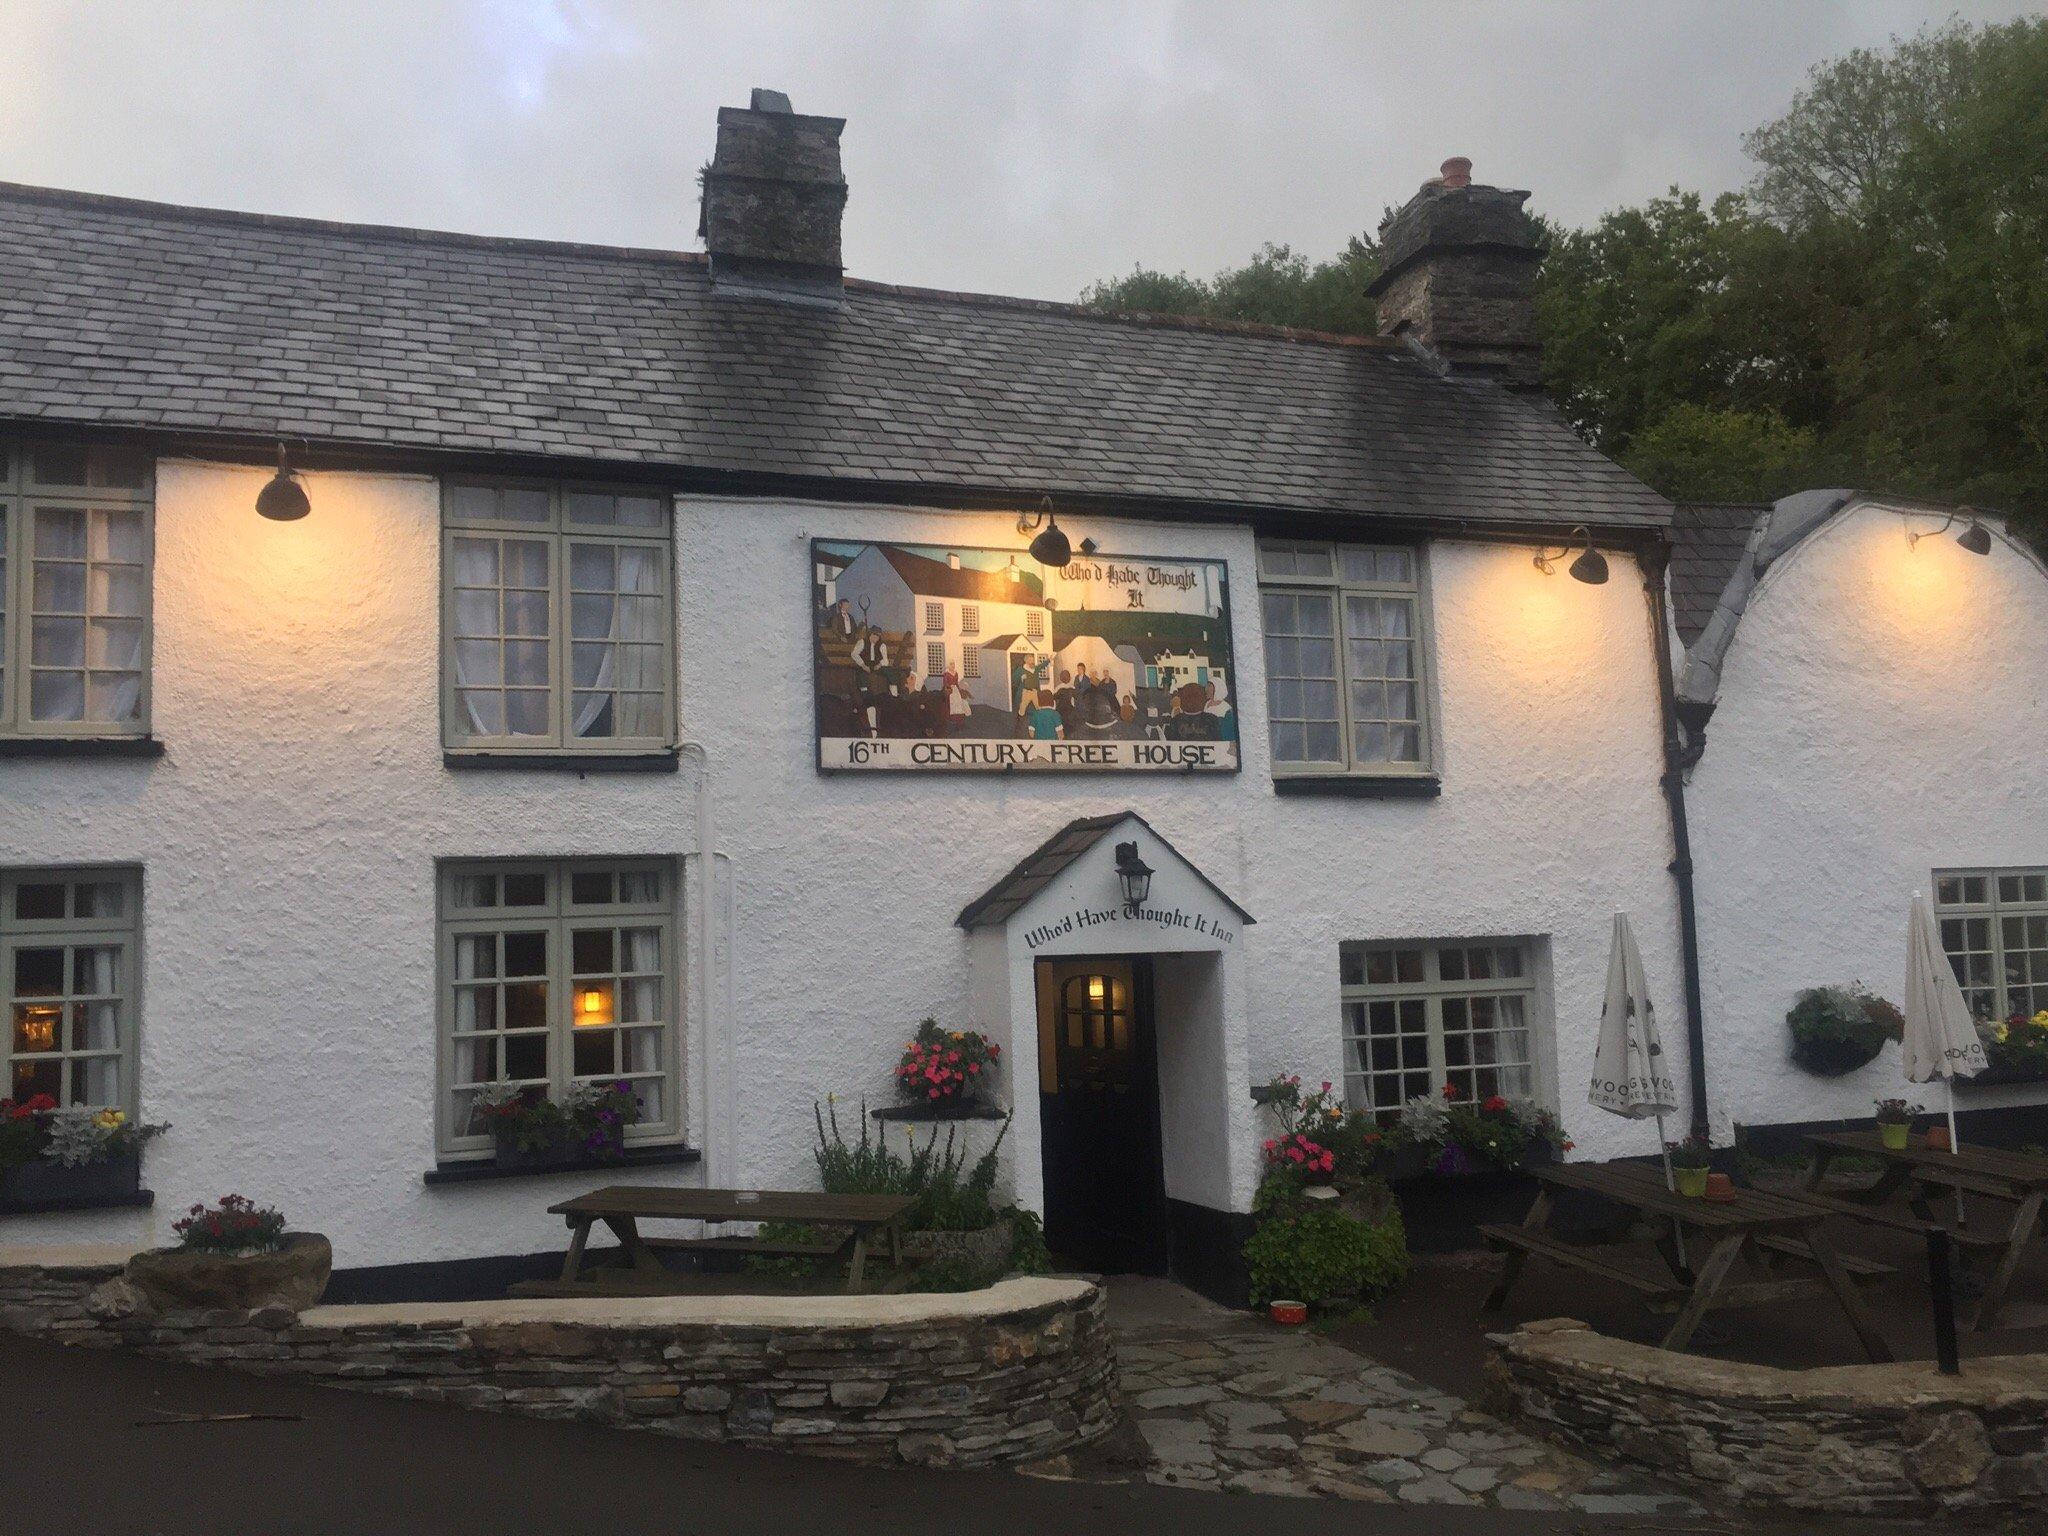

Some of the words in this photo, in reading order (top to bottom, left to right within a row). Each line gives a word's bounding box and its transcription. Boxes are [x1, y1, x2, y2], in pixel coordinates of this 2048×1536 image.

[1106, 565, 1140, 588] Have
[1147, 567, 1198, 591] Thought
[1126, 588, 1145, 608] It
[848, 741, 890, 763] 16TH
[911, 743, 1033, 763] CENTURY
[1050, 744, 1118, 764] FREE
[1133, 744, 1216, 765] HOUSE
[1024, 915, 1073, 949] Who'd
[1076, 908, 1117, 928] Have
[1121, 903, 1190, 930] Thought
[1194, 913, 1207, 933] It
[1210, 920, 1234, 944] Inn
